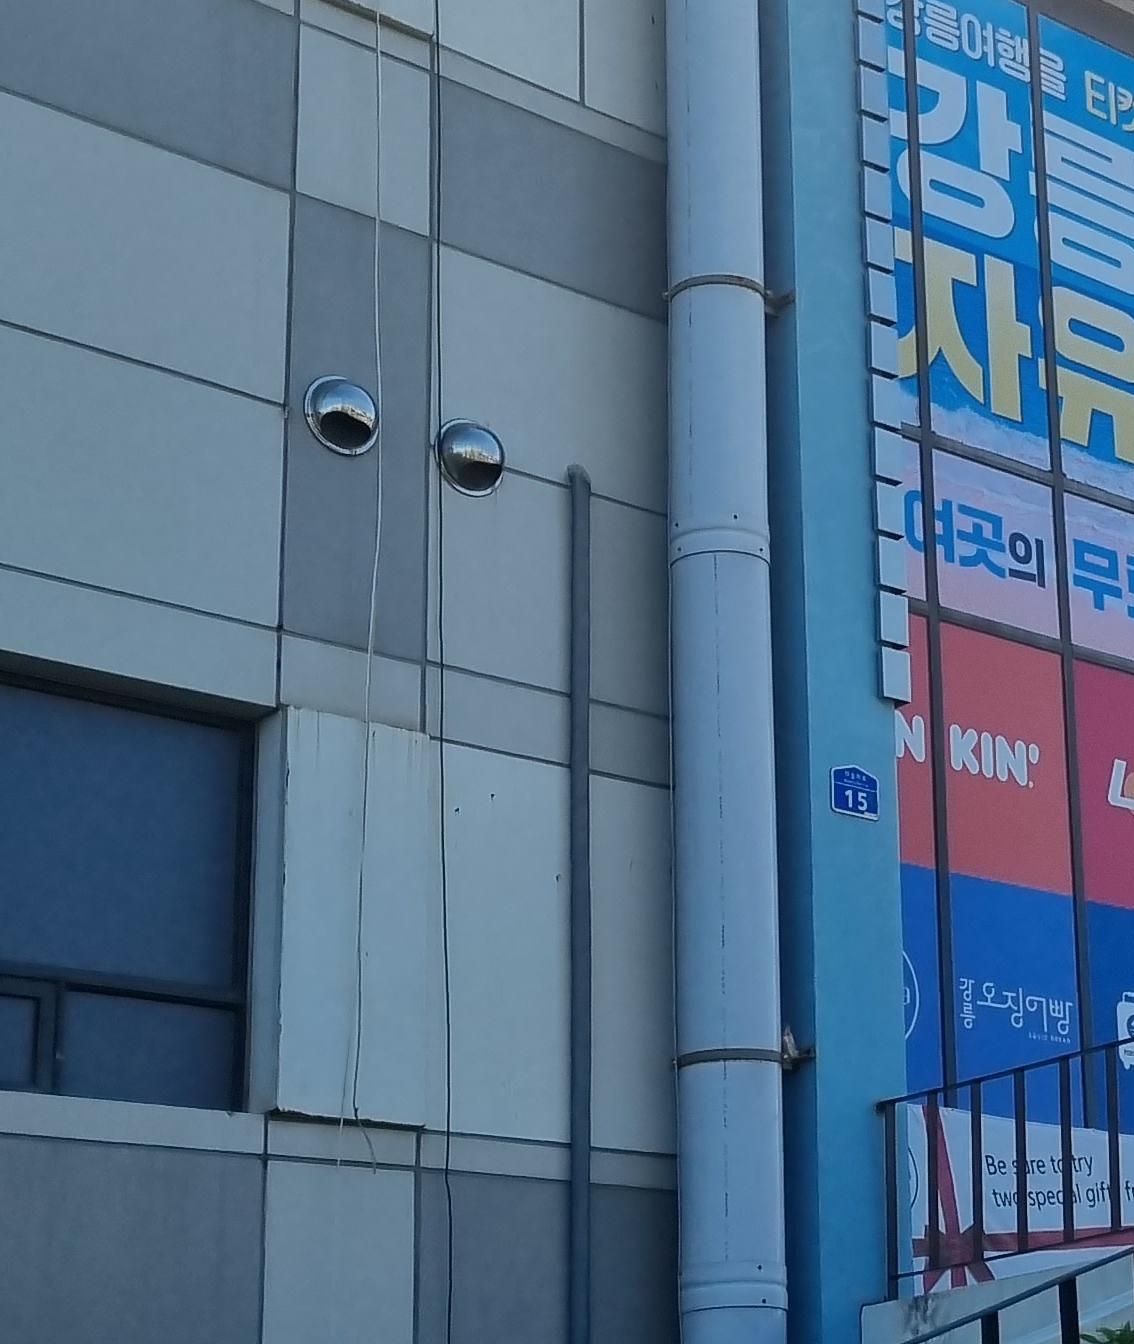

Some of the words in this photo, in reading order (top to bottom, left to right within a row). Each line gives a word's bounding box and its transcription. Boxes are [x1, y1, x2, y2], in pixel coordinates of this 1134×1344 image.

[845, 789, 868, 811] 15
[985, 1154, 1007, 1175] Be
[1050, 1156, 1065, 1175] to
[1072, 1154, 1093, 1177] try
[1028, 1189, 1081, 1211] specal
[1086, 1180, 1113, 1208] gift
